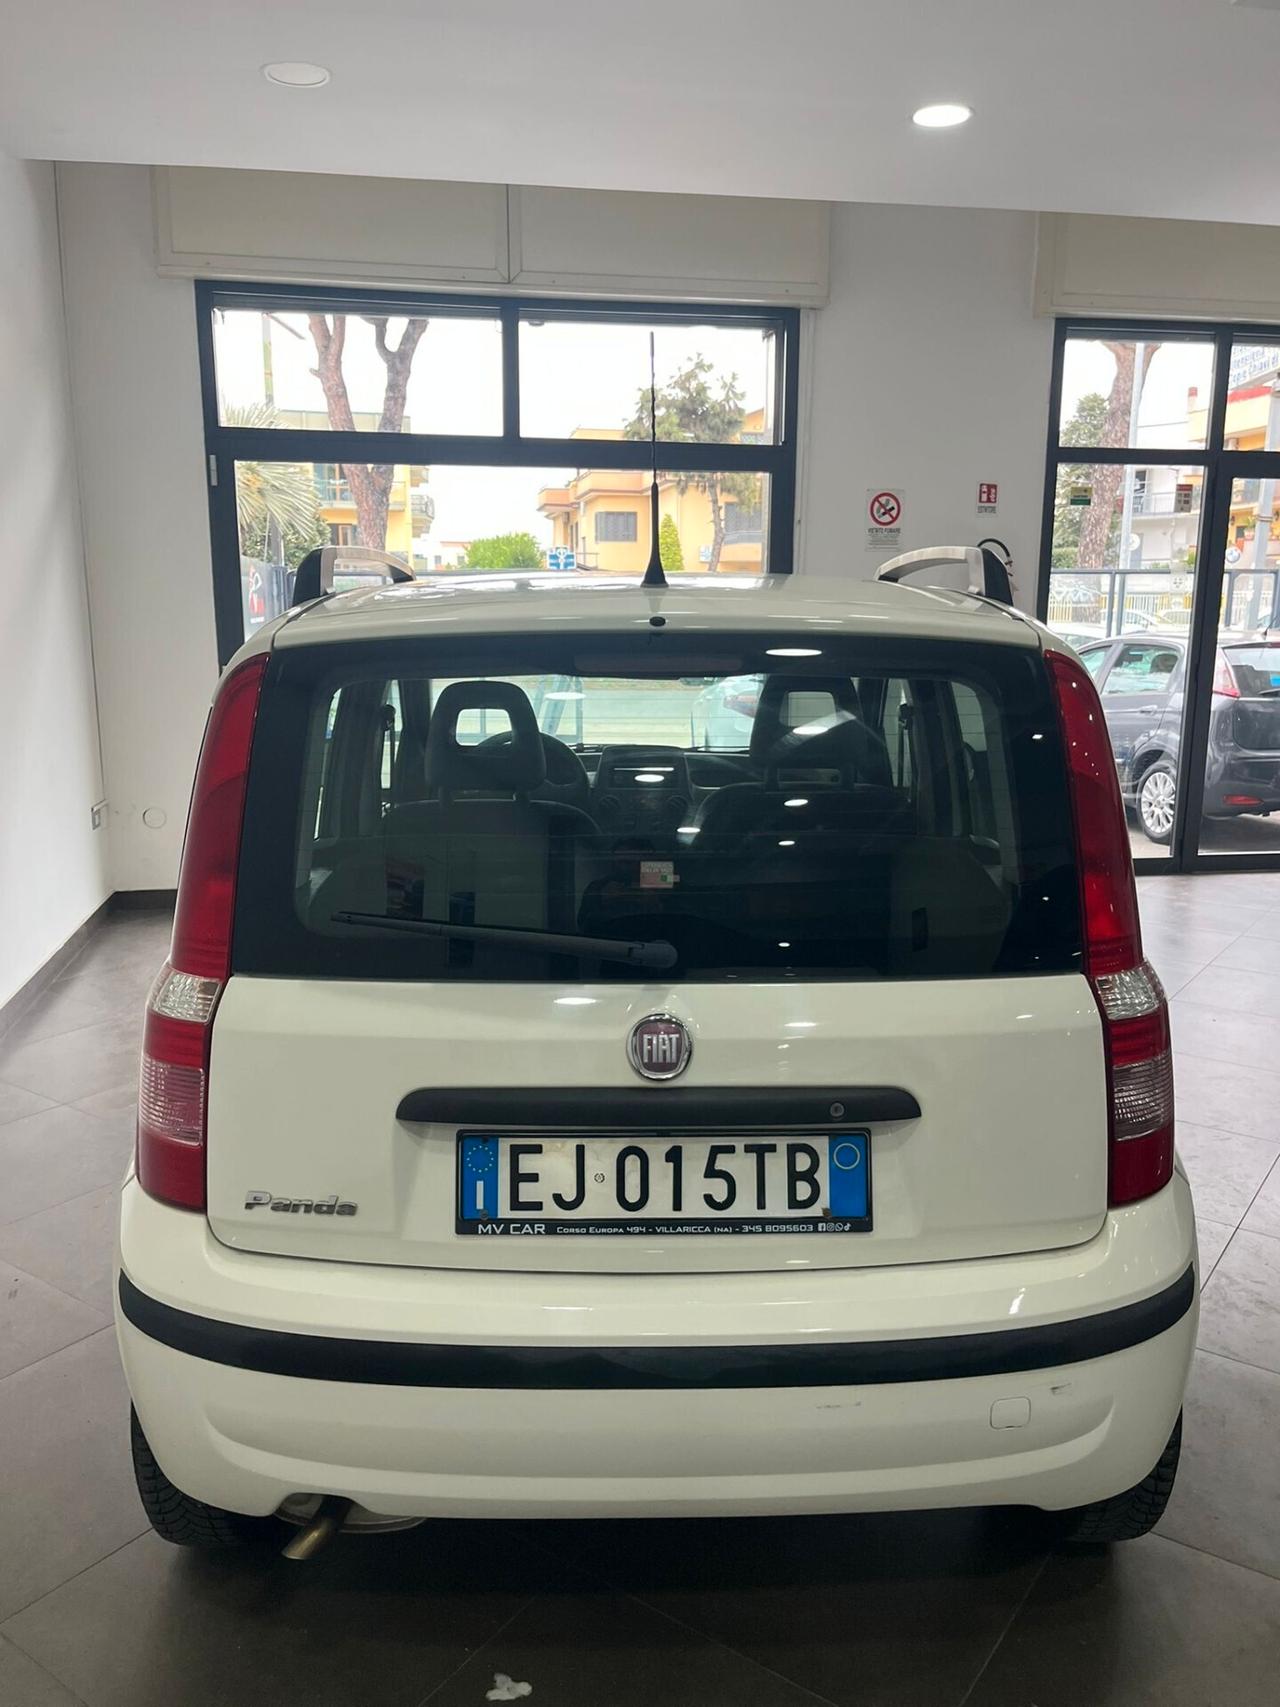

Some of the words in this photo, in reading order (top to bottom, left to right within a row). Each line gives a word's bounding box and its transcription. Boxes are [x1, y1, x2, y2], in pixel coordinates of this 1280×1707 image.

[642, 1033, 680, 1063] FIAT
[244, 1191, 358, 1216] Panda
[477, 1223, 505, 1235] MV
[509, 1223, 546, 1235] CAR
[765, 1224, 814, 1232] 8095603
